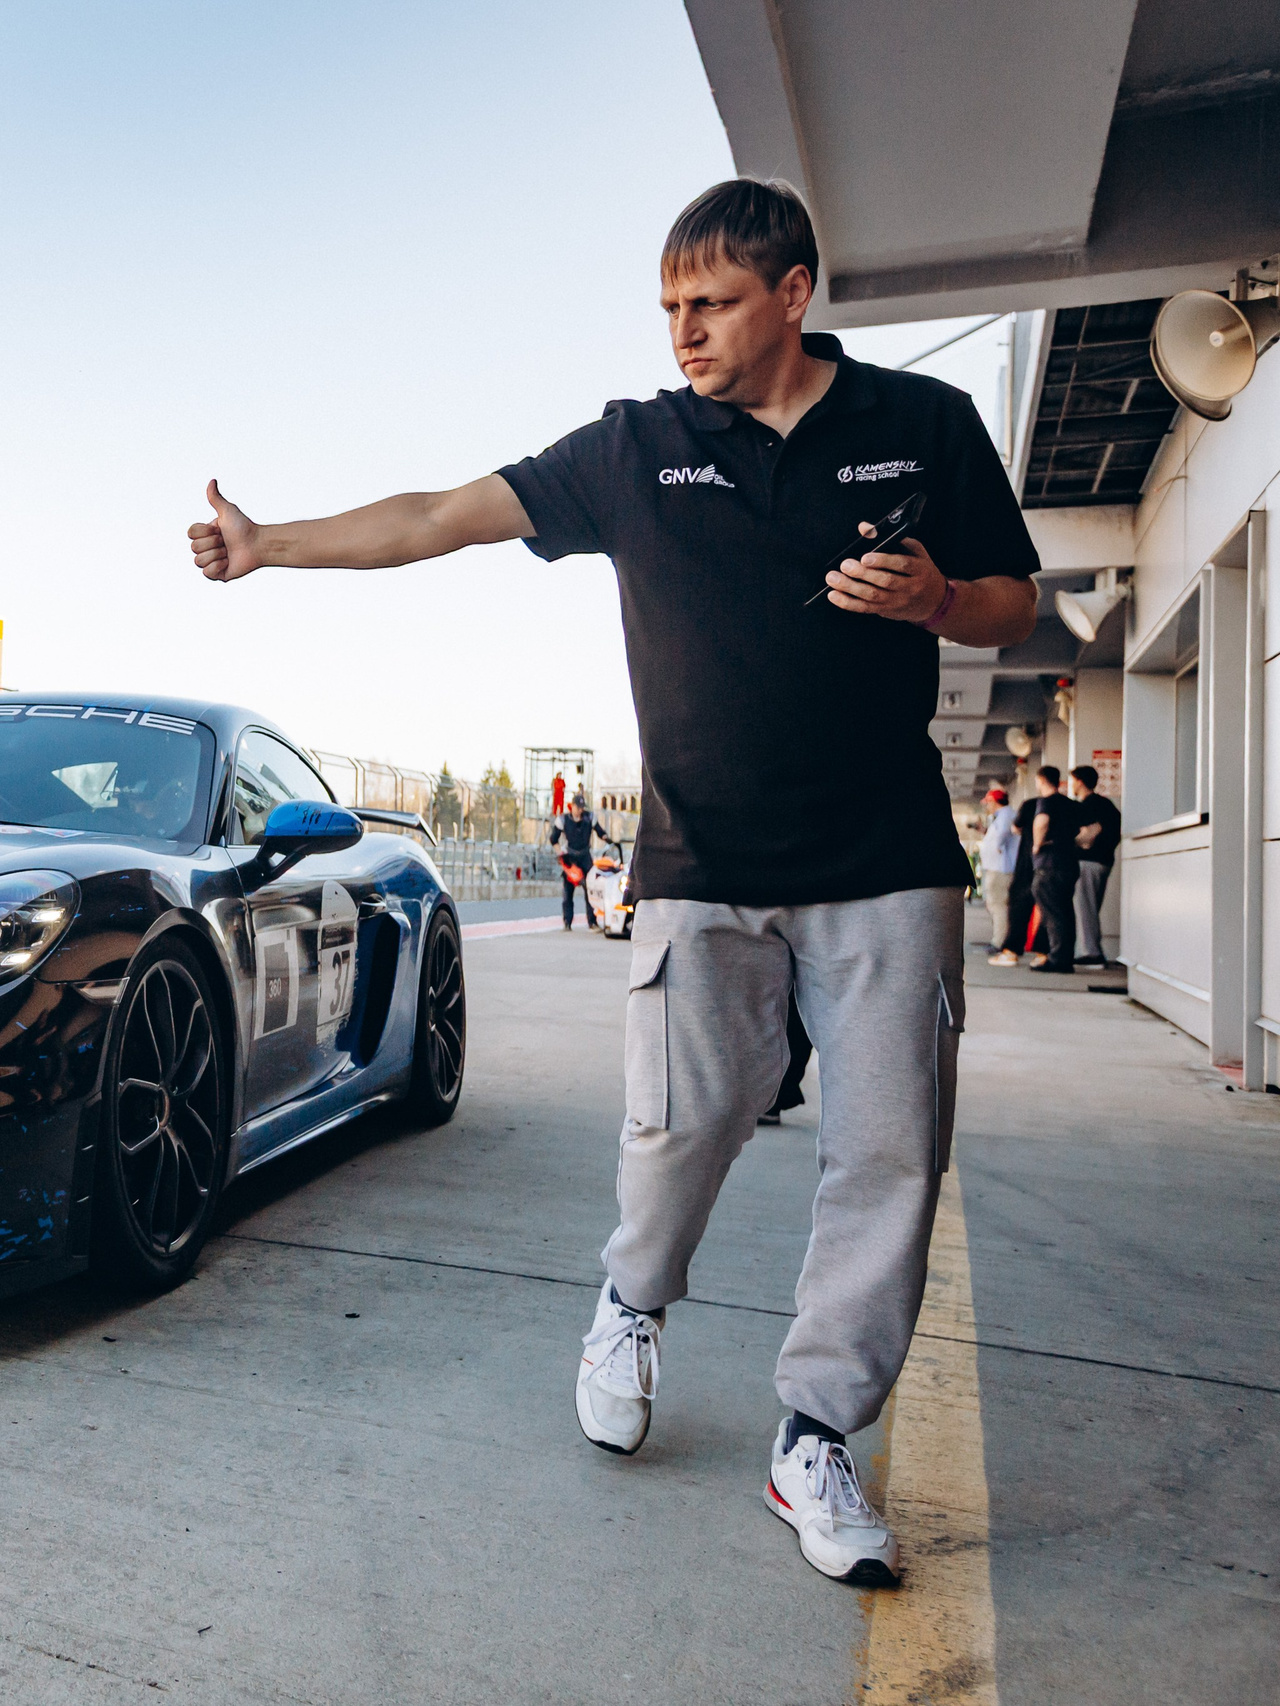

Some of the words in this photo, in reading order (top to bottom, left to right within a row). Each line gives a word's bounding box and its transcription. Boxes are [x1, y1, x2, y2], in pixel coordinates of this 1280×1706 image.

[855, 460, 917, 474] KAMENSKIY
[658, 467, 701, 485] GNV
[877, 471, 899, 480] school
[330, 951, 351, 1016] 37
